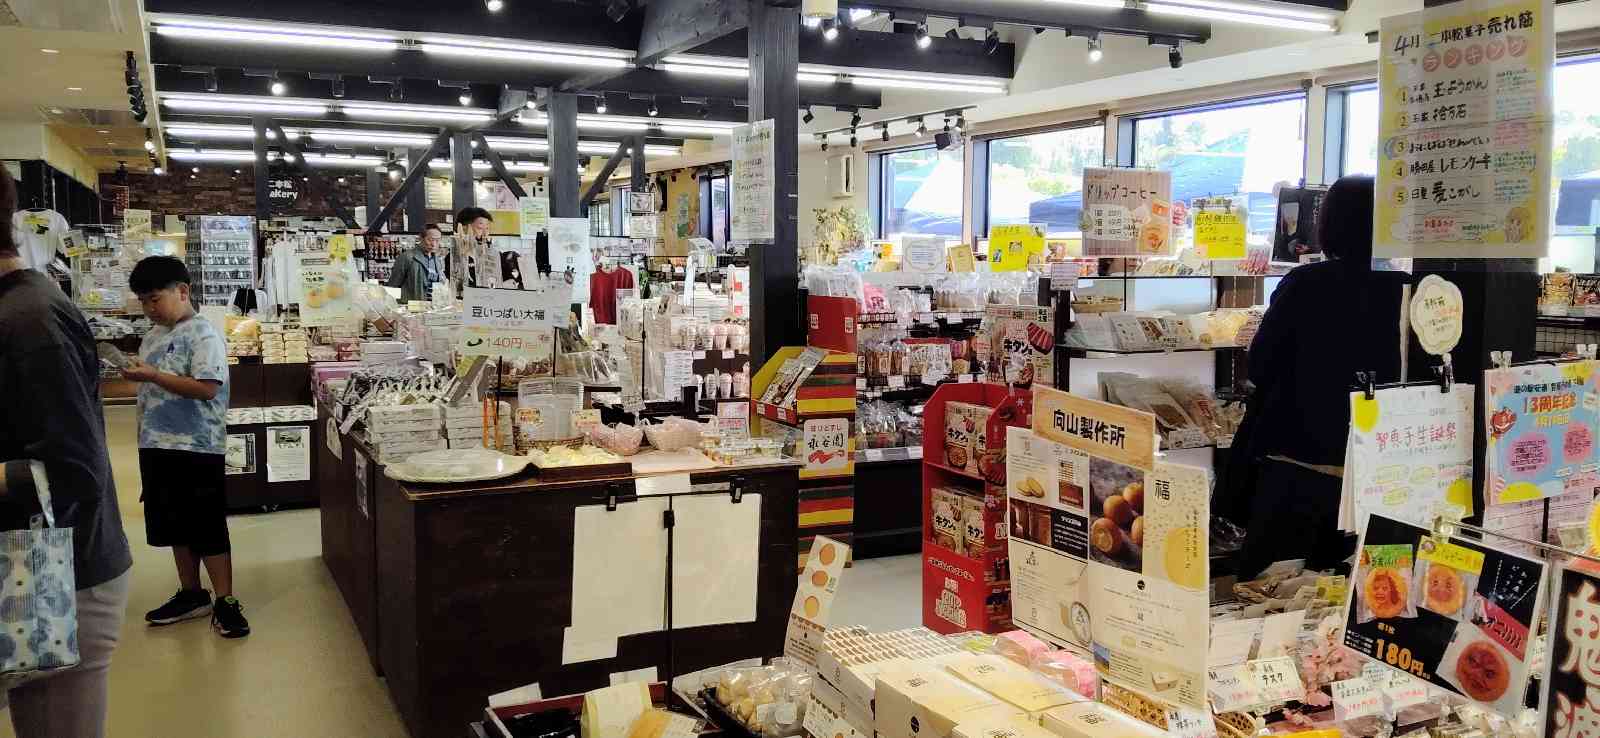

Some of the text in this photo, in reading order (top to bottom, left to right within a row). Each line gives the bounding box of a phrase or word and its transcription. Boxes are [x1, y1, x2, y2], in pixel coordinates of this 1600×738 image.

[1394, 34, 1420, 57] 4月
[269, 189, 299, 200] akery
[1087, 183, 1157, 200] ドリップコーヒー
[472, 305, 545, 321] 豆いっぱい大福
[486, 336, 522, 349] 140円
[1053, 408, 1126, 450] 向山製作所
[807, 432, 844, 450] 永谷園
[1154, 479, 1171, 501] 福
[1376, 638, 1425, 674] 180円
